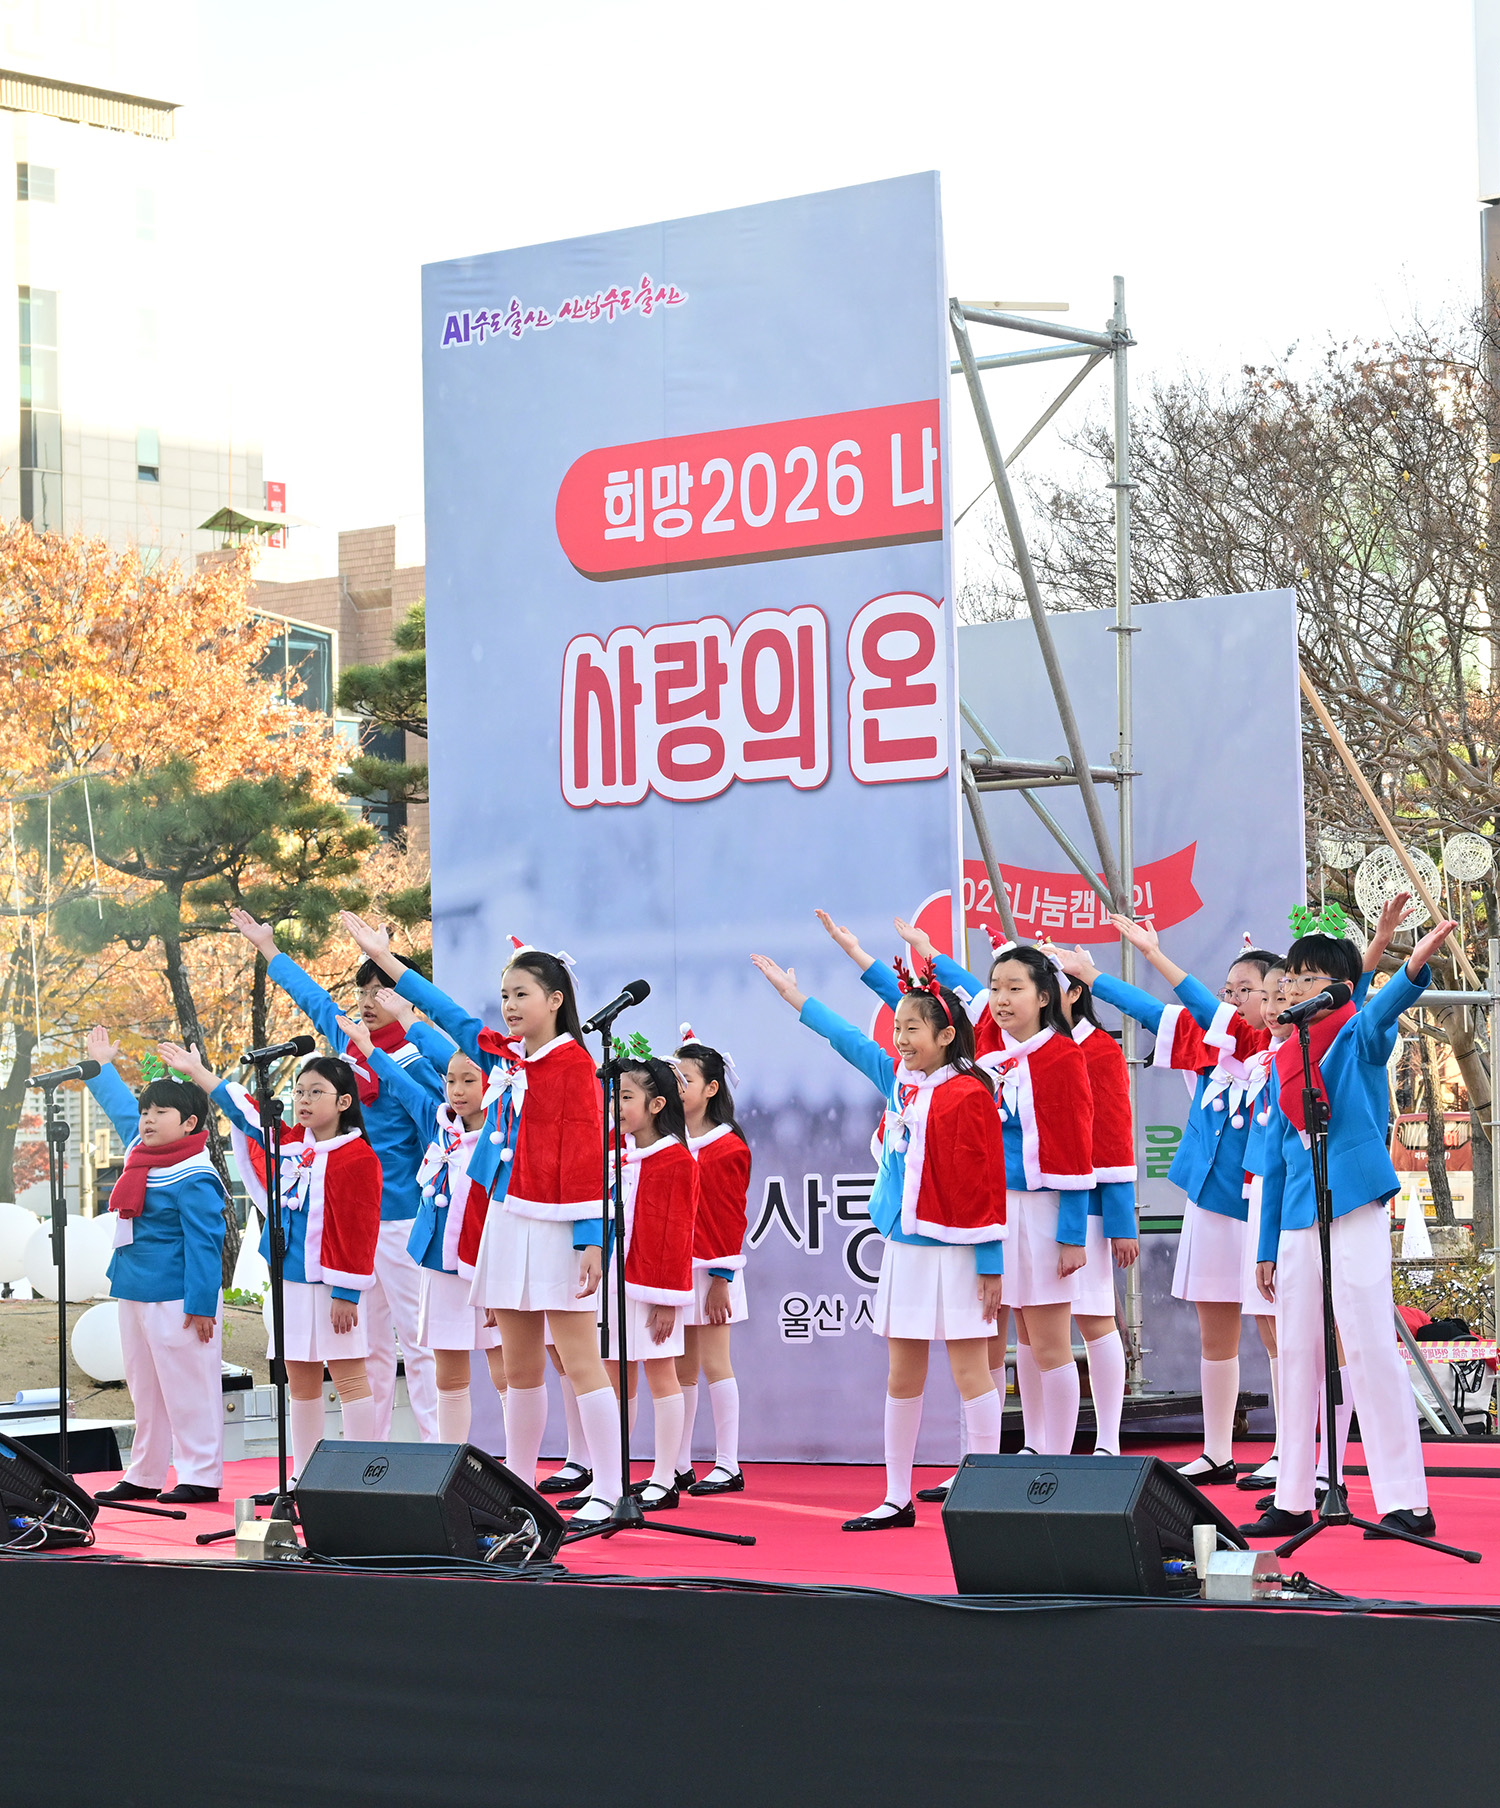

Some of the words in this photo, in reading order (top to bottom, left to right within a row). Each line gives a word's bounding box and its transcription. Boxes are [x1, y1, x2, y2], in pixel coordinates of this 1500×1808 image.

[442, 299, 553, 346] AI수도울산
[558, 275, 687, 321] 산업수도울산
[603, 437, 865, 543] 희망2026
[890, 427, 938, 507] 나
[570, 622, 819, 793] 사랑의
[859, 610, 940, 766] 온
[781, 1297, 845, 1338] 울산
[364, 1465, 387, 1477] RCF
[1029, 1482, 1056, 1495] RCF
